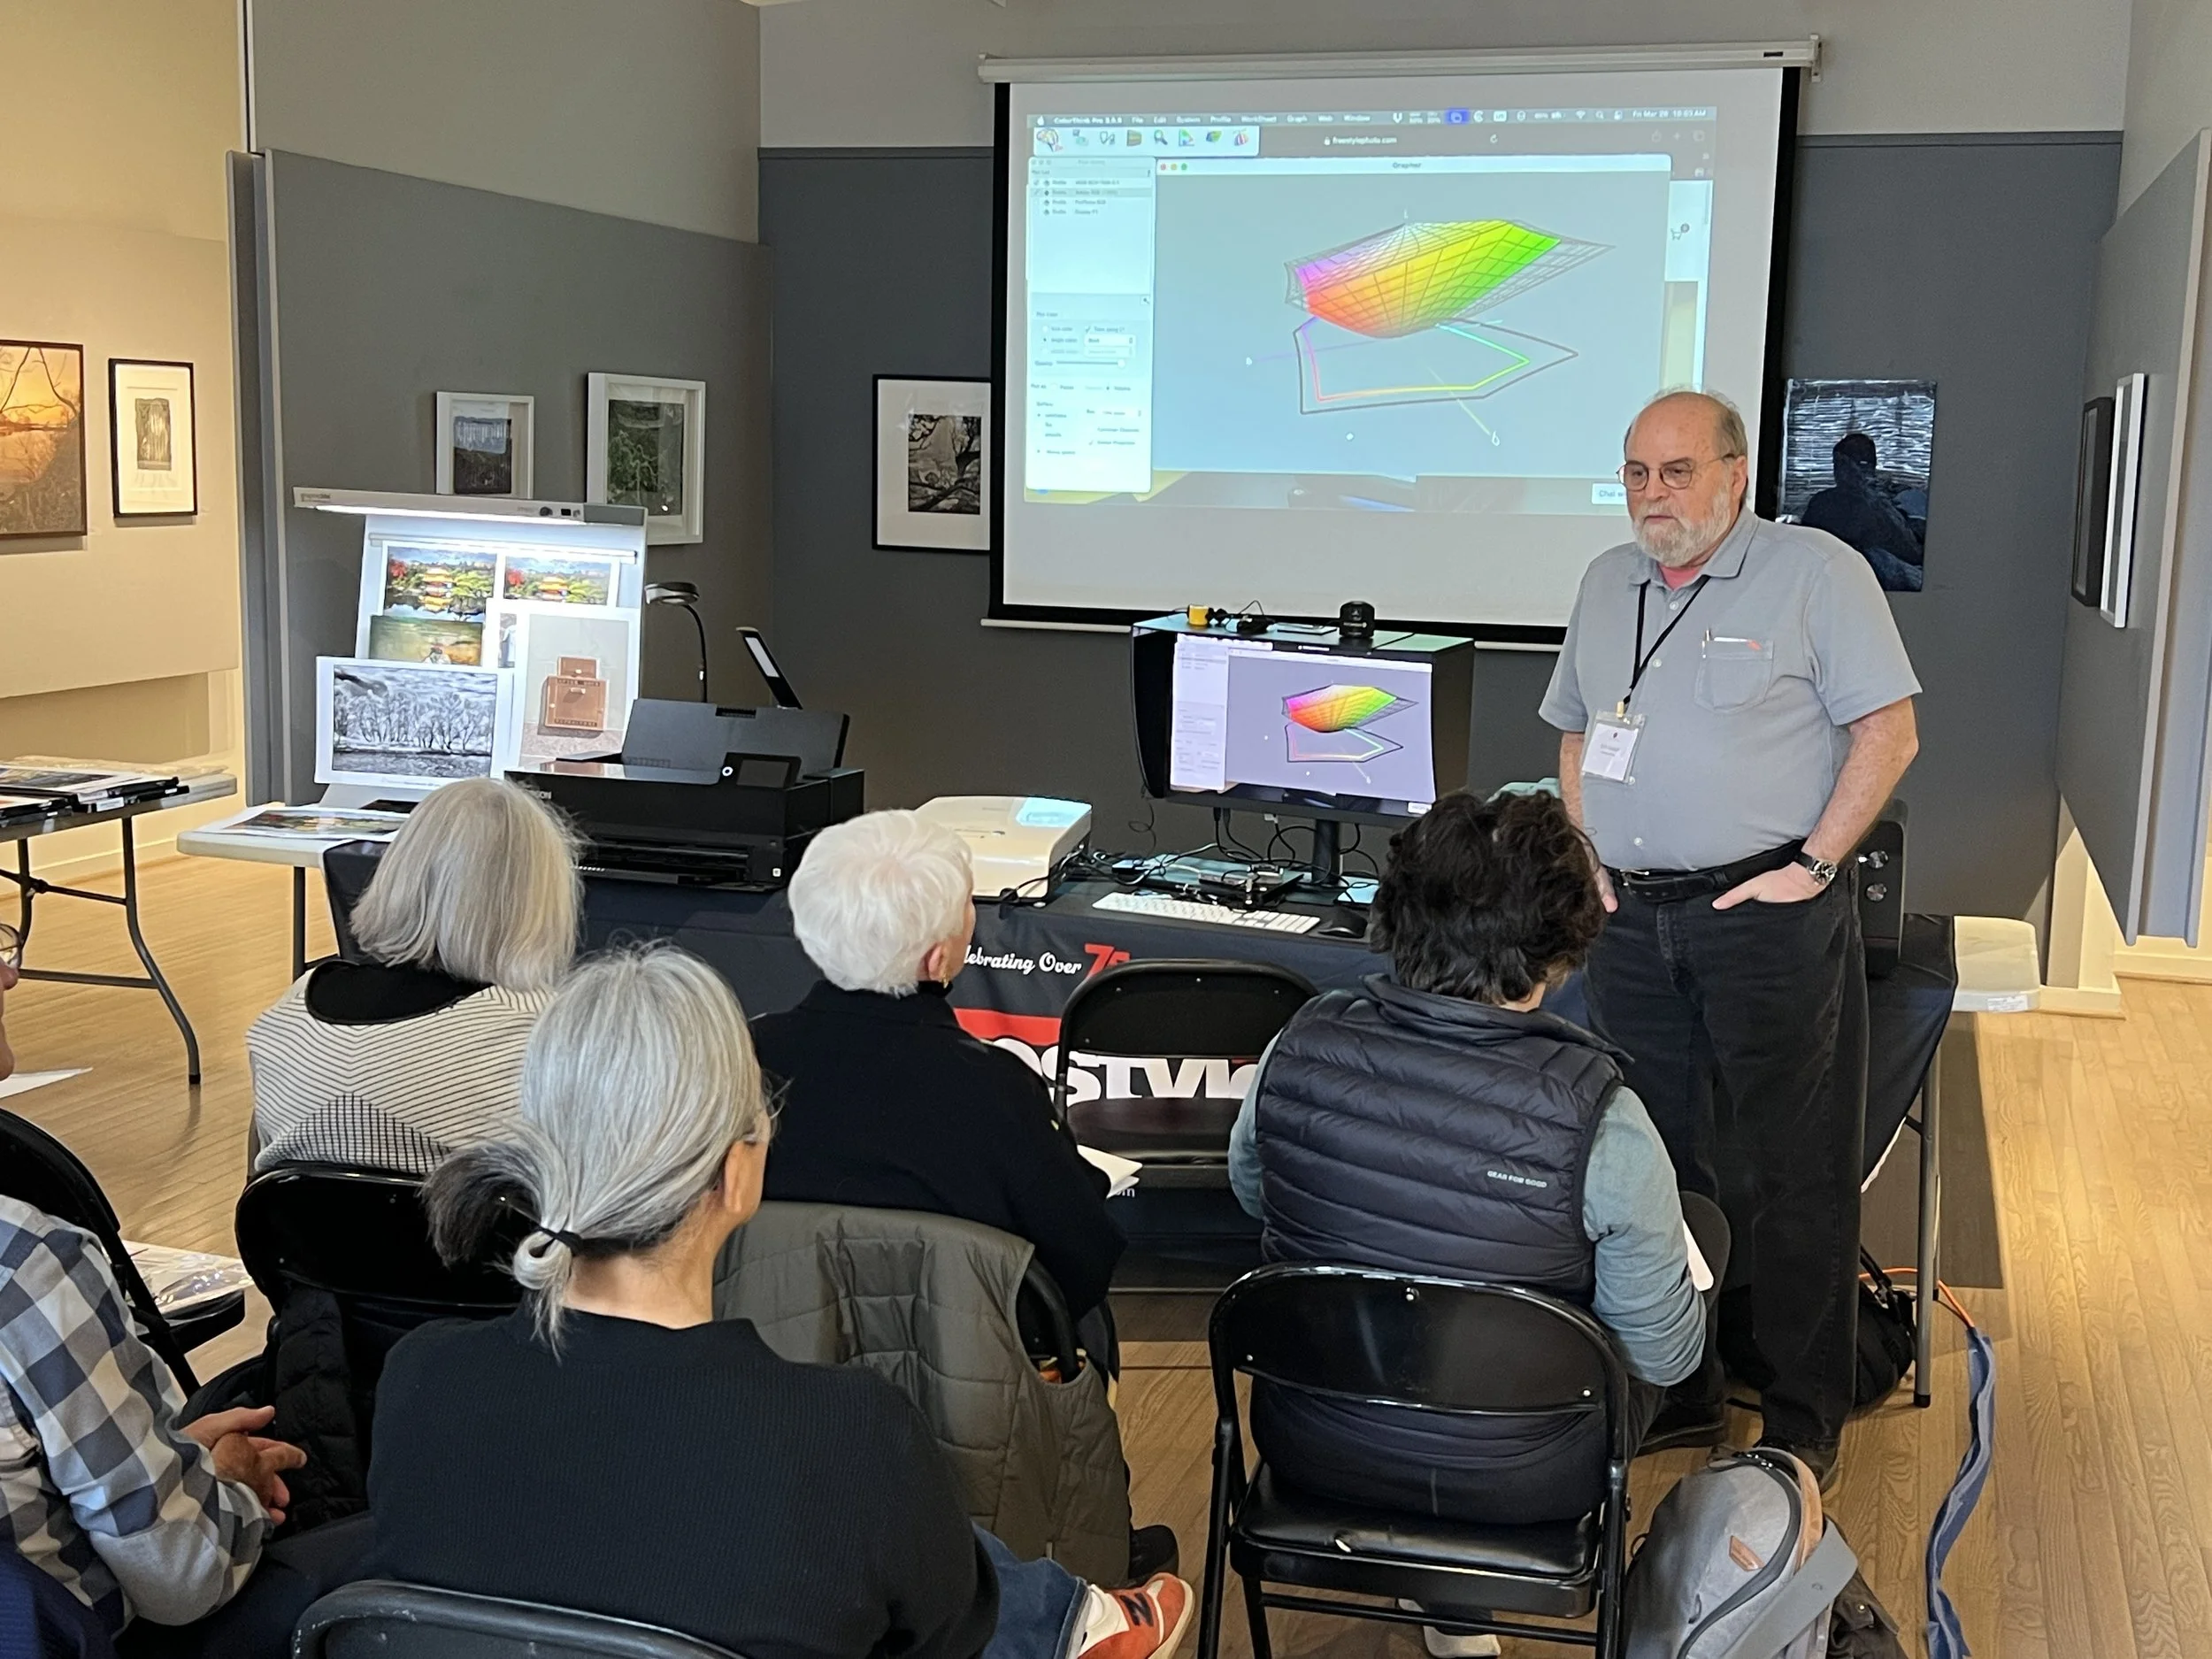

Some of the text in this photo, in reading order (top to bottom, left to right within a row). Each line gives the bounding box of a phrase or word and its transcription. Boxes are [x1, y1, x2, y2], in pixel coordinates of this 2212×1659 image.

[1210, 115, 1232, 124] Profile
[1286, 114, 1308, 123] Graph
[1344, 113, 1371, 122] Window
[1039, 952, 1082, 974] Over
[1487, 1170, 1508, 1180] GEAR
[1508, 1174, 1525, 1184] FOR
